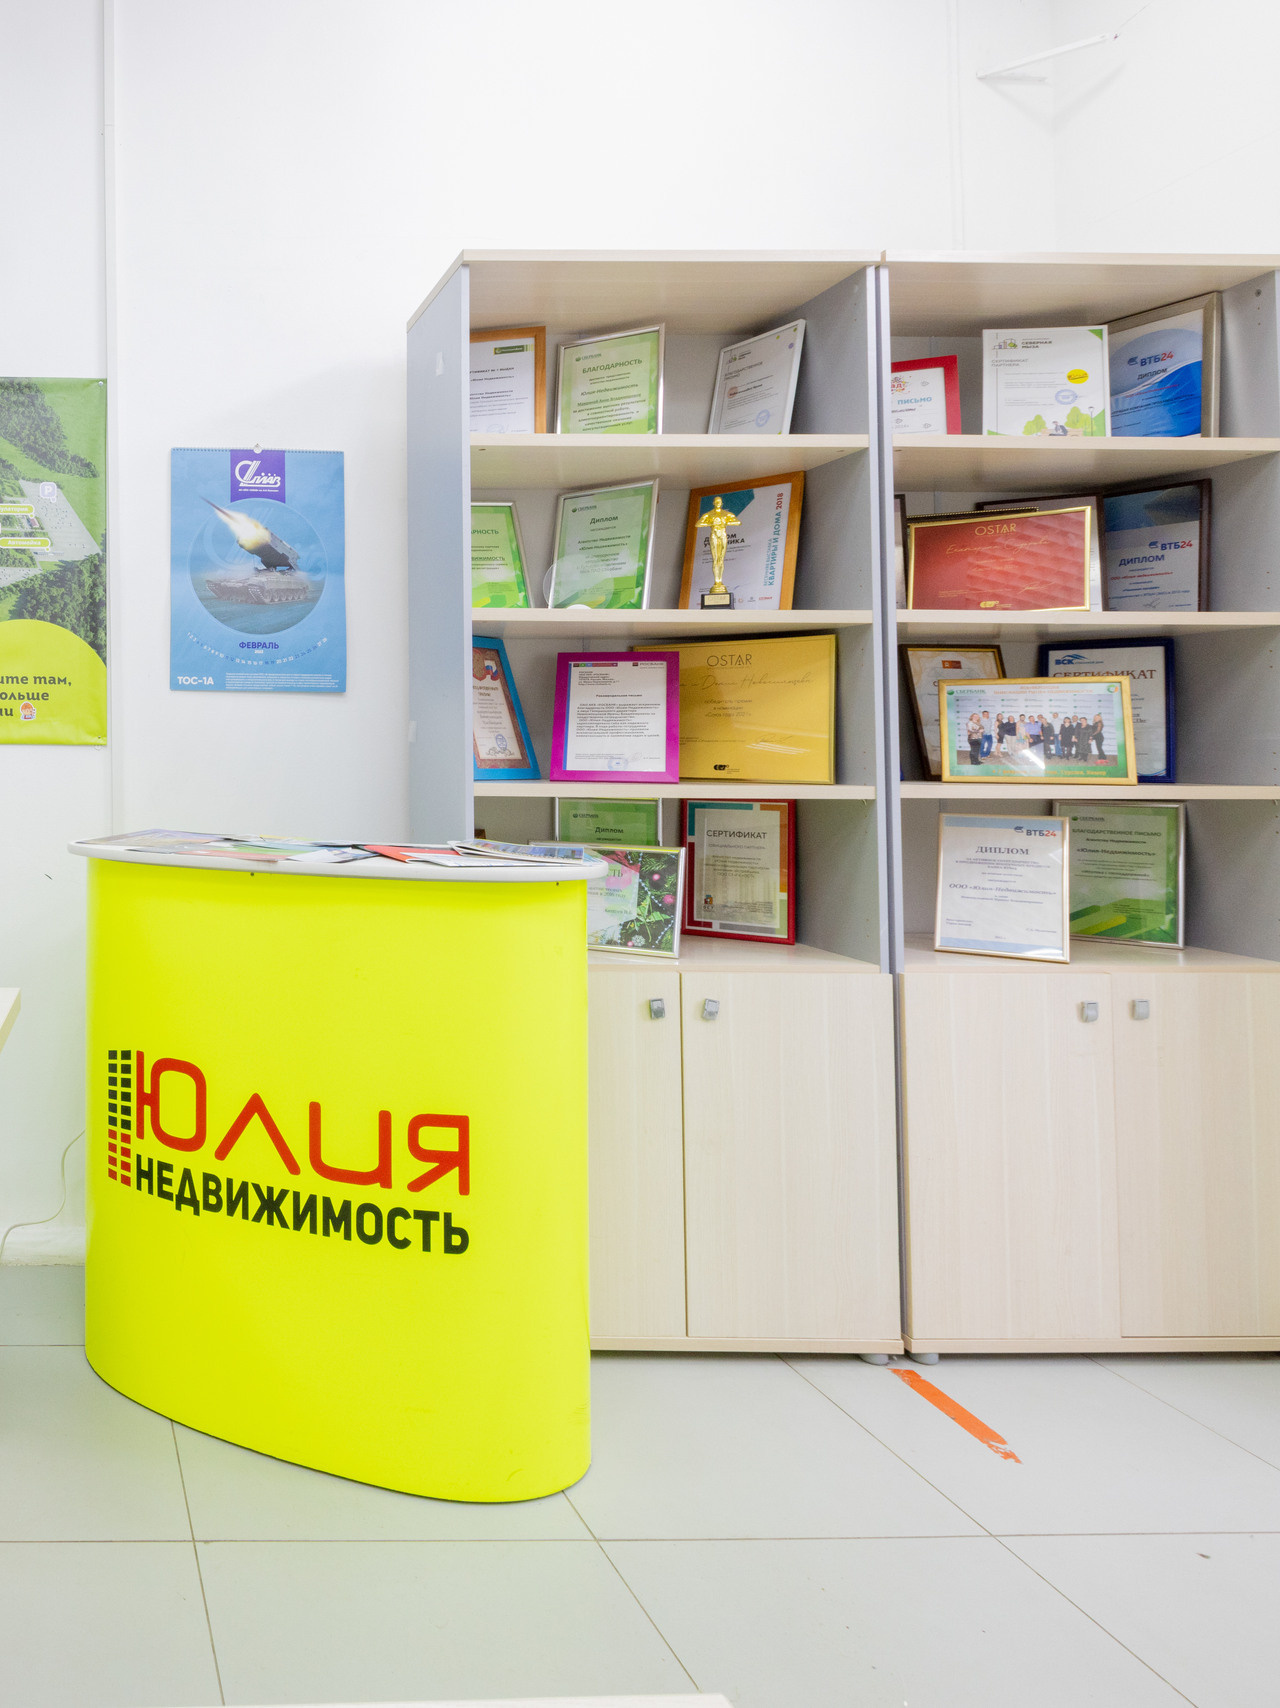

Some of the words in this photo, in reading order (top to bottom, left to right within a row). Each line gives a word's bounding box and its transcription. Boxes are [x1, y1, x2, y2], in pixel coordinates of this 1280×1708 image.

[1140, 351, 1174, 367] ВТБ24
[582, 358, 643, 374] БЛАГОДАРНОСТЬ
[1137, 368, 1168, 381] ДИПЛОМ
[775, 492, 784, 511] 2018
[589, 515, 619, 525] Диплом
[772, 511, 782, 536] ДОМА
[974, 523, 1017, 536] OSTAR
[1160, 540, 1193, 551] ВТБ24
[768, 544, 779, 586] КВАРТИРЫ
[1118, 554, 1165, 567] ДИПЛОМ
[238, 641, 280, 650] ФЕВРАЛЬ
[706, 653, 753, 667] OSTAR
[1055, 658, 1074, 666] ВСК
[33, 676, 72, 687] там,
[177, 676, 215, 686] ТОС-1А
[595, 826, 624, 834] Диплом
[706, 829, 767, 839] СЕРТИФИКАТ
[1025, 829, 1057, 837] ВТБ24
[975, 846, 1029, 856] ДИПЛОМ
[136, 1153, 470, 1255] НЕДВИЖИМОСТЬ
